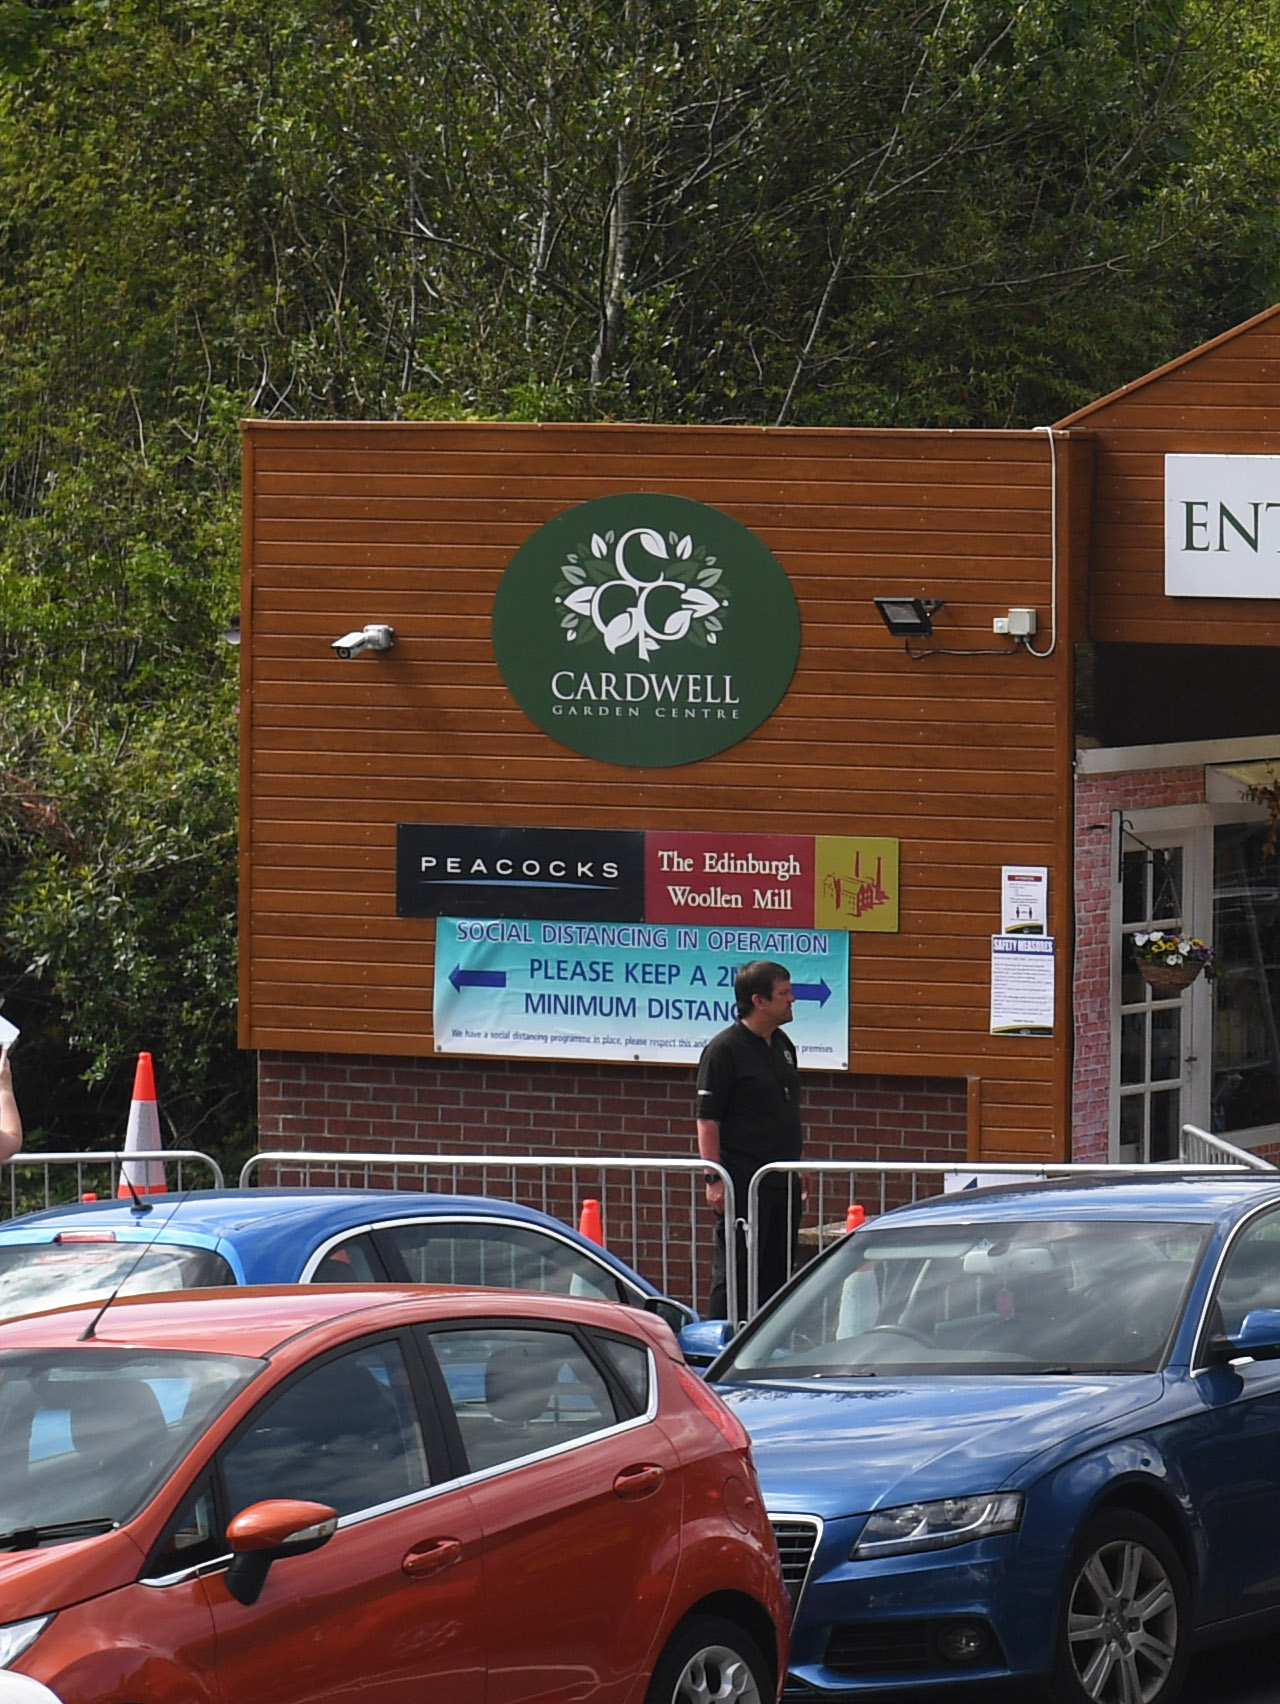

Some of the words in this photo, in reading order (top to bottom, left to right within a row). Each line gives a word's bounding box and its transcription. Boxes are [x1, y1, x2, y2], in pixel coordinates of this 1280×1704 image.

[551, 671, 740, 704] CARDWELL
[552, 705, 640, 717] GARDEN
[655, 707, 740, 720] CENTRE
[421, 856, 619, 878] PEACOCKS
[658, 850, 694, 872] The
[703, 852, 801, 881] Edinburgh
[667, 885, 743, 908] Woollen
[753, 888, 793, 910] Mill
[457, 921, 534, 943] SOCIAL
[542, 924, 667, 948] DISTANCING
[677, 929, 698, 949] IN
[707, 930, 829, 955] OPERATION
[529, 958, 614, 983] PLEASE
[625, 962, 681, 985] KEEP
[690, 965, 708, 987] A
[524, 992, 637, 1018] MINIMUM
[648, 998, 740, 1022] DISTANC
[451, 1029, 463, 1038] We
[465, 1029, 482, 1039] have
[491, 1031, 510, 1040] social
[513, 1032, 549, 1044] distancing
[550, 1035, 591, 1045] programme
[593, 1035, 601, 1044] in
[625, 1036, 648, 1047] please
[650, 1039, 676, 1049] respect
[679, 1039, 691, 1048] this
[693, 1039, 707, 1048] and
[802, 1045, 832, 1054] premises
